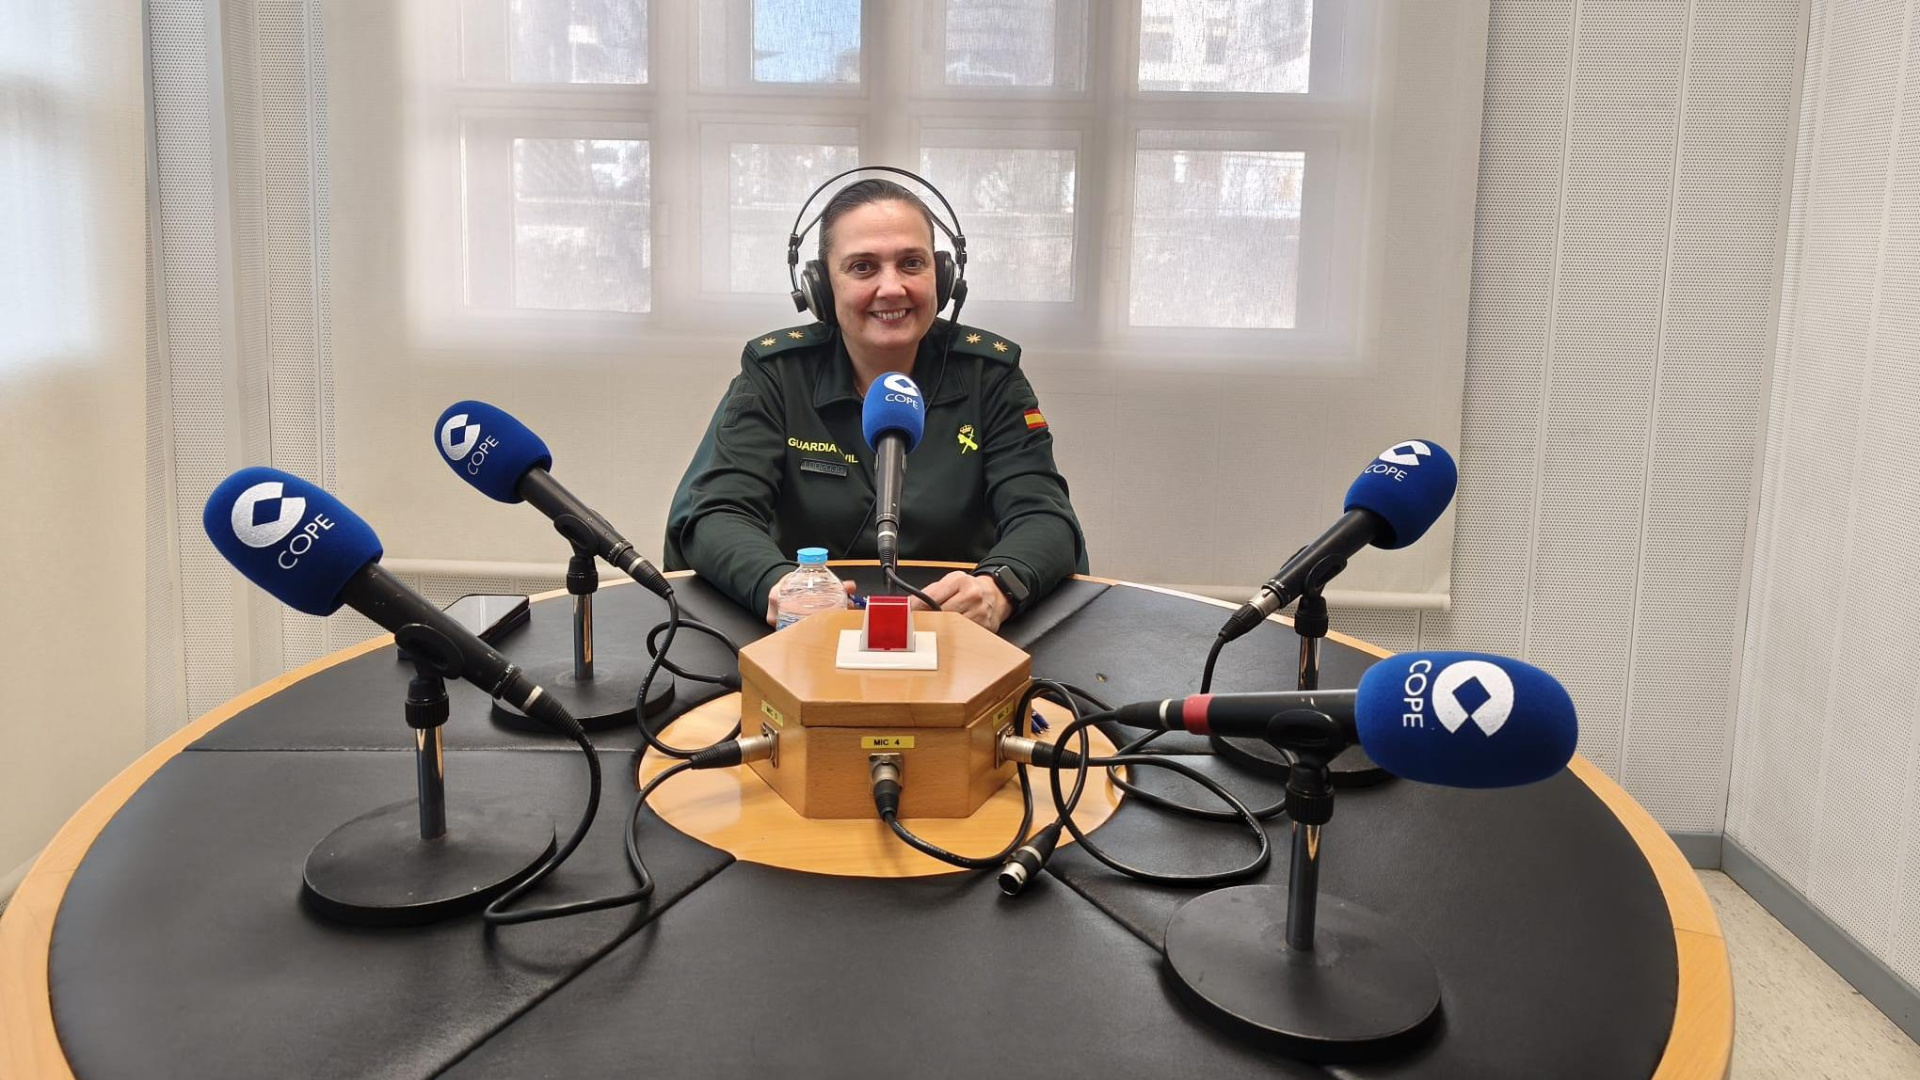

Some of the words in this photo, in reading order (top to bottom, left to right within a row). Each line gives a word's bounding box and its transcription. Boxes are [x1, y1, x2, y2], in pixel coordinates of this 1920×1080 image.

[885, 393, 918, 410] COPE
[787, 437, 838, 453] GUARDIA
[467, 435, 499, 475] COPE
[1364, 464, 1408, 482] COPE
[278, 513, 335, 570] COPE
[1403, 660, 1432, 728] COPE
[873, 738, 889, 746] MIC
[894, 738, 900, 746] 4
